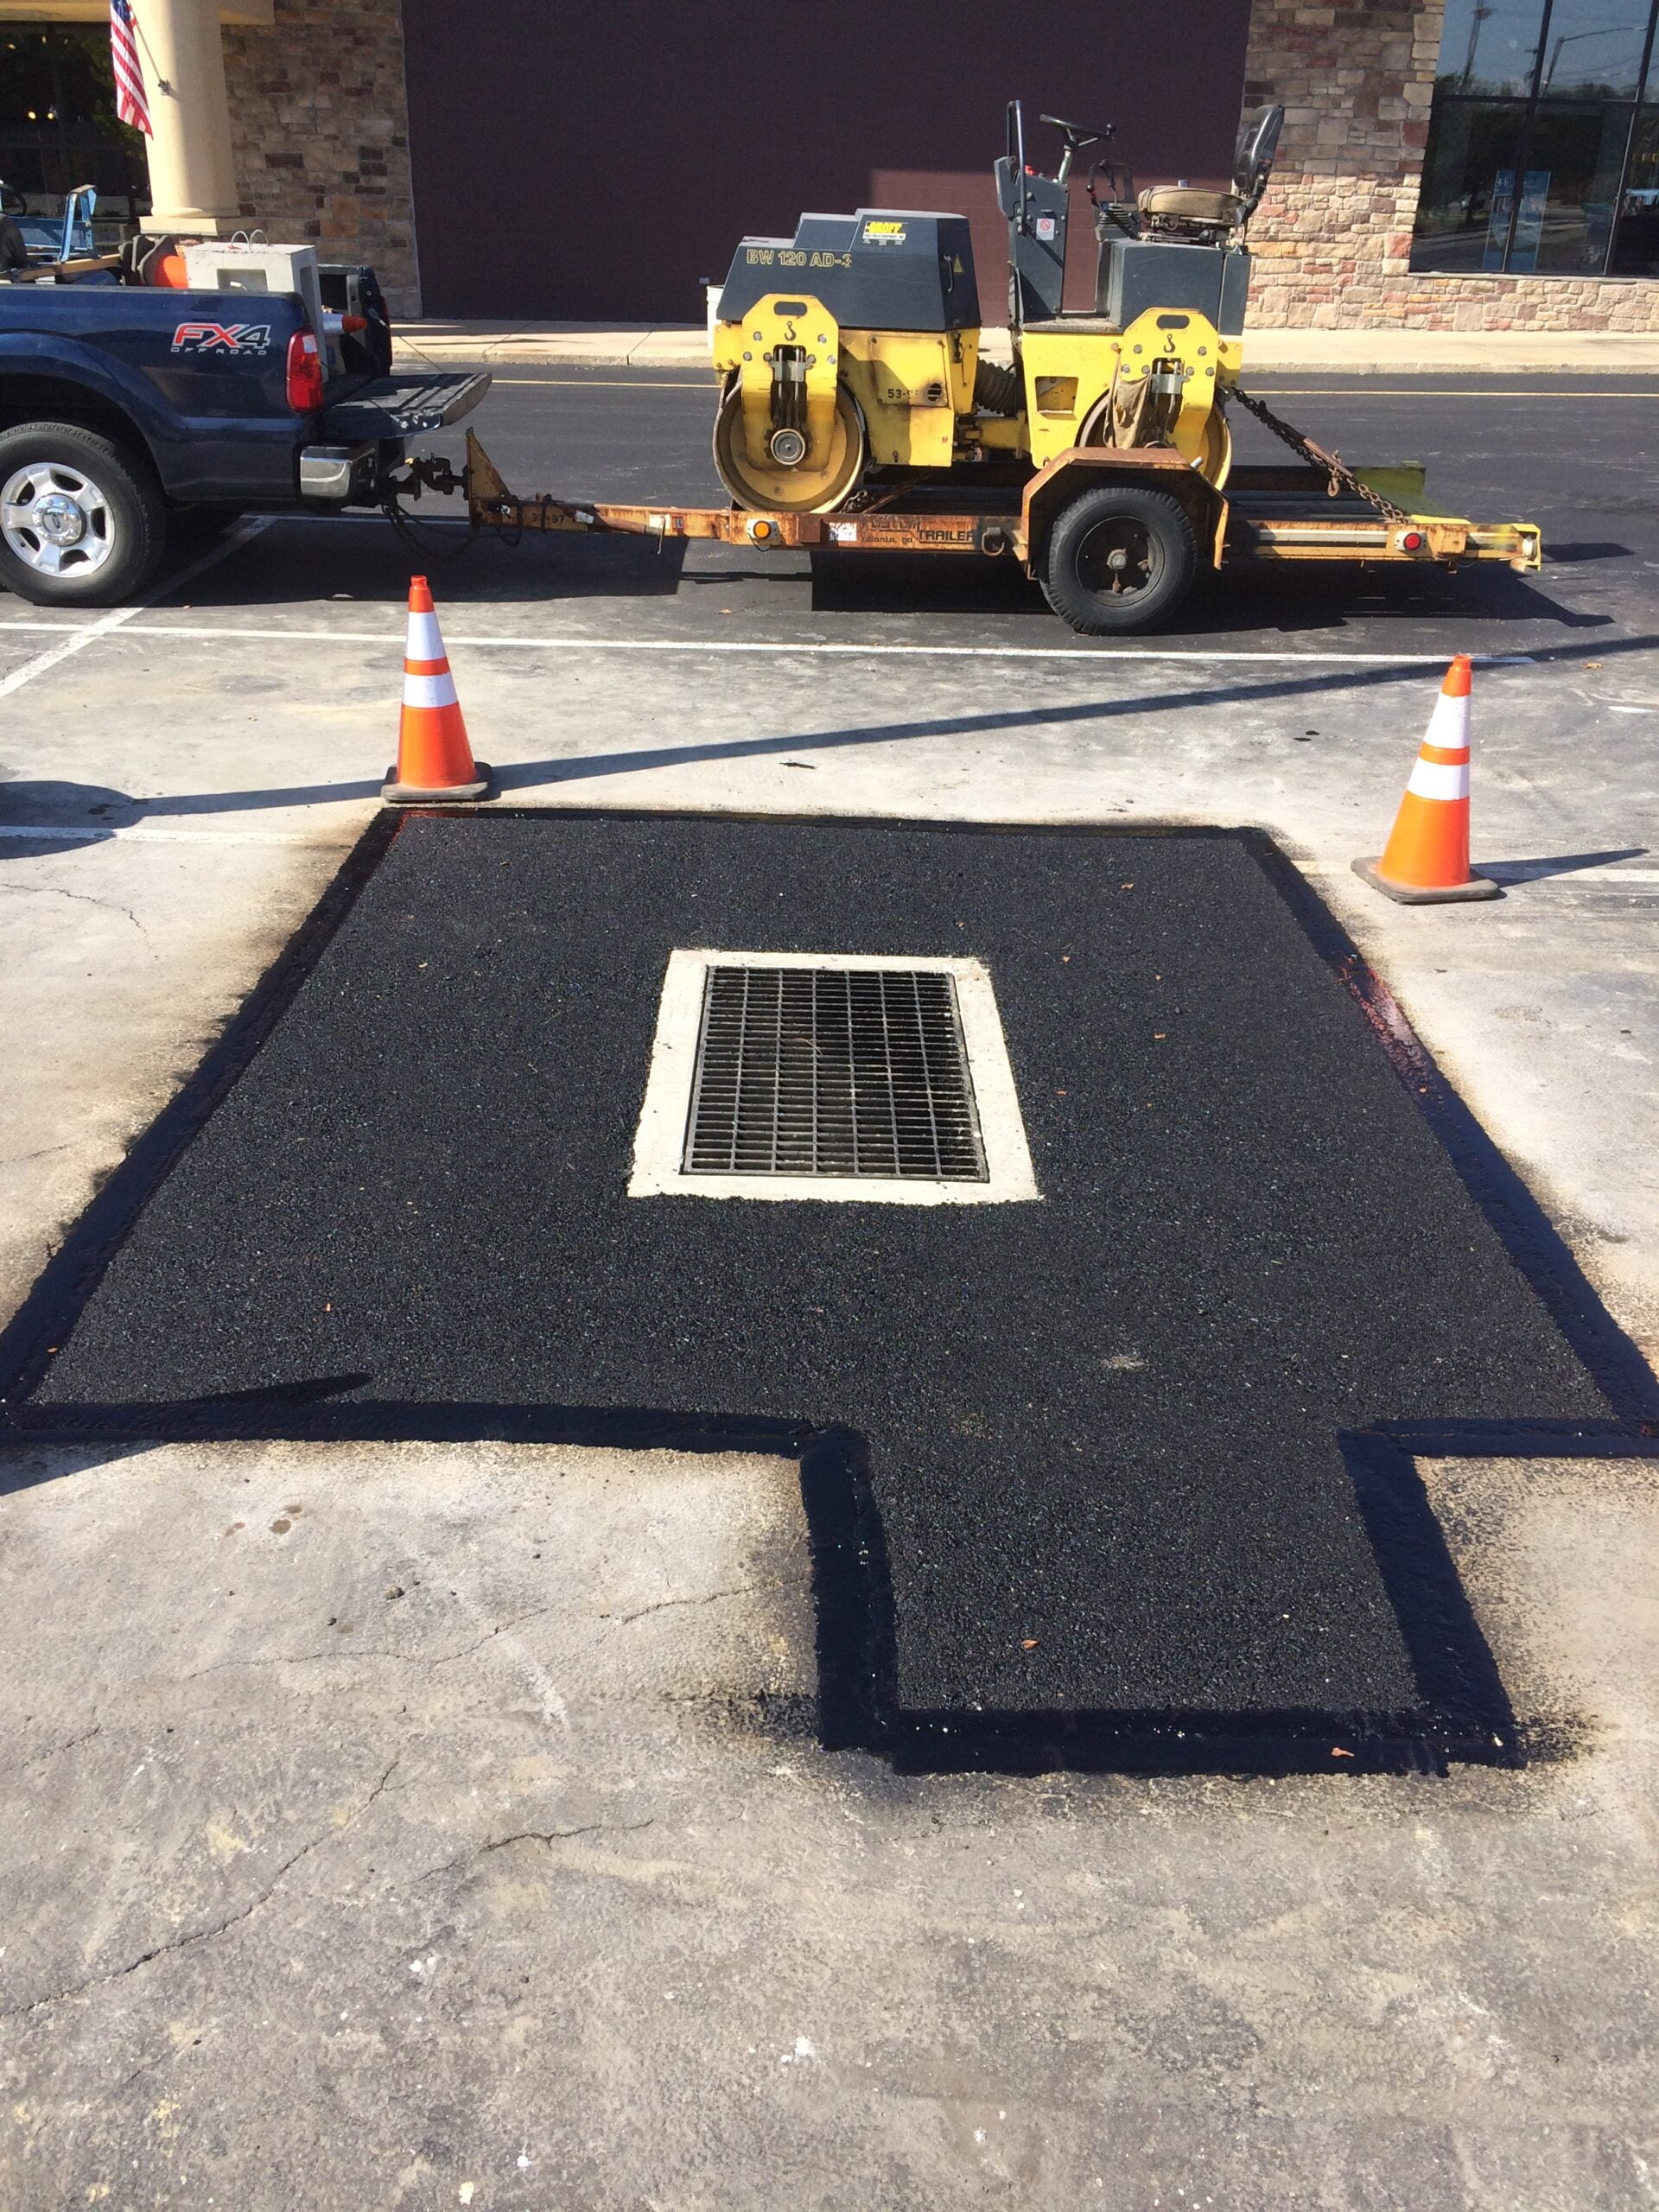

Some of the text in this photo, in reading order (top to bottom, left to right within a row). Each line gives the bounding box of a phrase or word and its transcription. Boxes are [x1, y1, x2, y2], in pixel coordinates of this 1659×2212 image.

[746, 249, 853, 268] BW 120 AD-3
[171, 321, 271, 349] FX4
[918, 530, 974, 541] TRAILER
